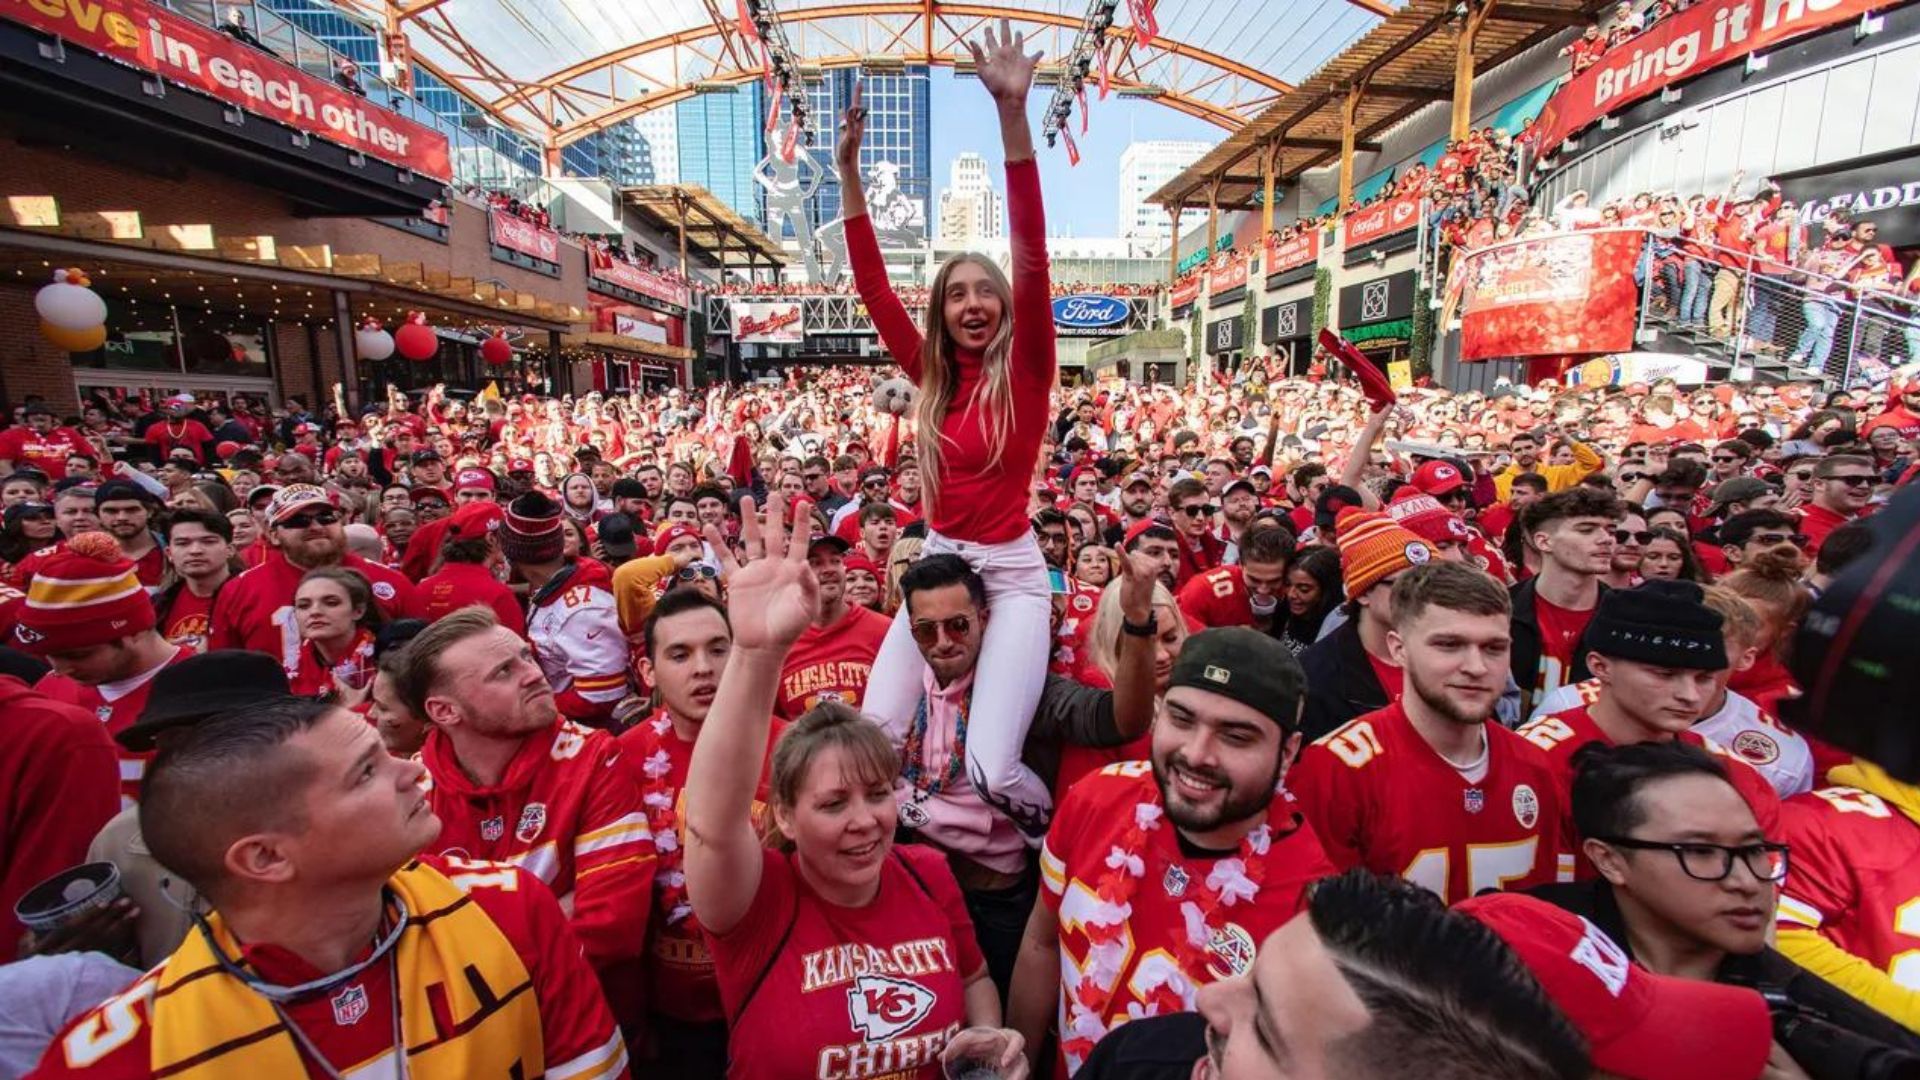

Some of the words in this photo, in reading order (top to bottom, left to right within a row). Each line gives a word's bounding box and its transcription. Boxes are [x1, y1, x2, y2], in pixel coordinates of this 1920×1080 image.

[1593, 30, 1700, 106] Bring
[1711, 7, 1751, 51] it
[148, 18, 200, 75] in
[208, 57, 316, 121] each
[322, 104, 409, 155] other
[1062, 298, 1115, 321] Ford
[563, 584, 593, 608] 87
[1207, 569, 1235, 599] 10
[784, 661, 838, 702] KANSAS
[838, 661, 873, 688] CITY
[892, 937, 956, 975] CITY
[864, 987, 916, 1024] KC
